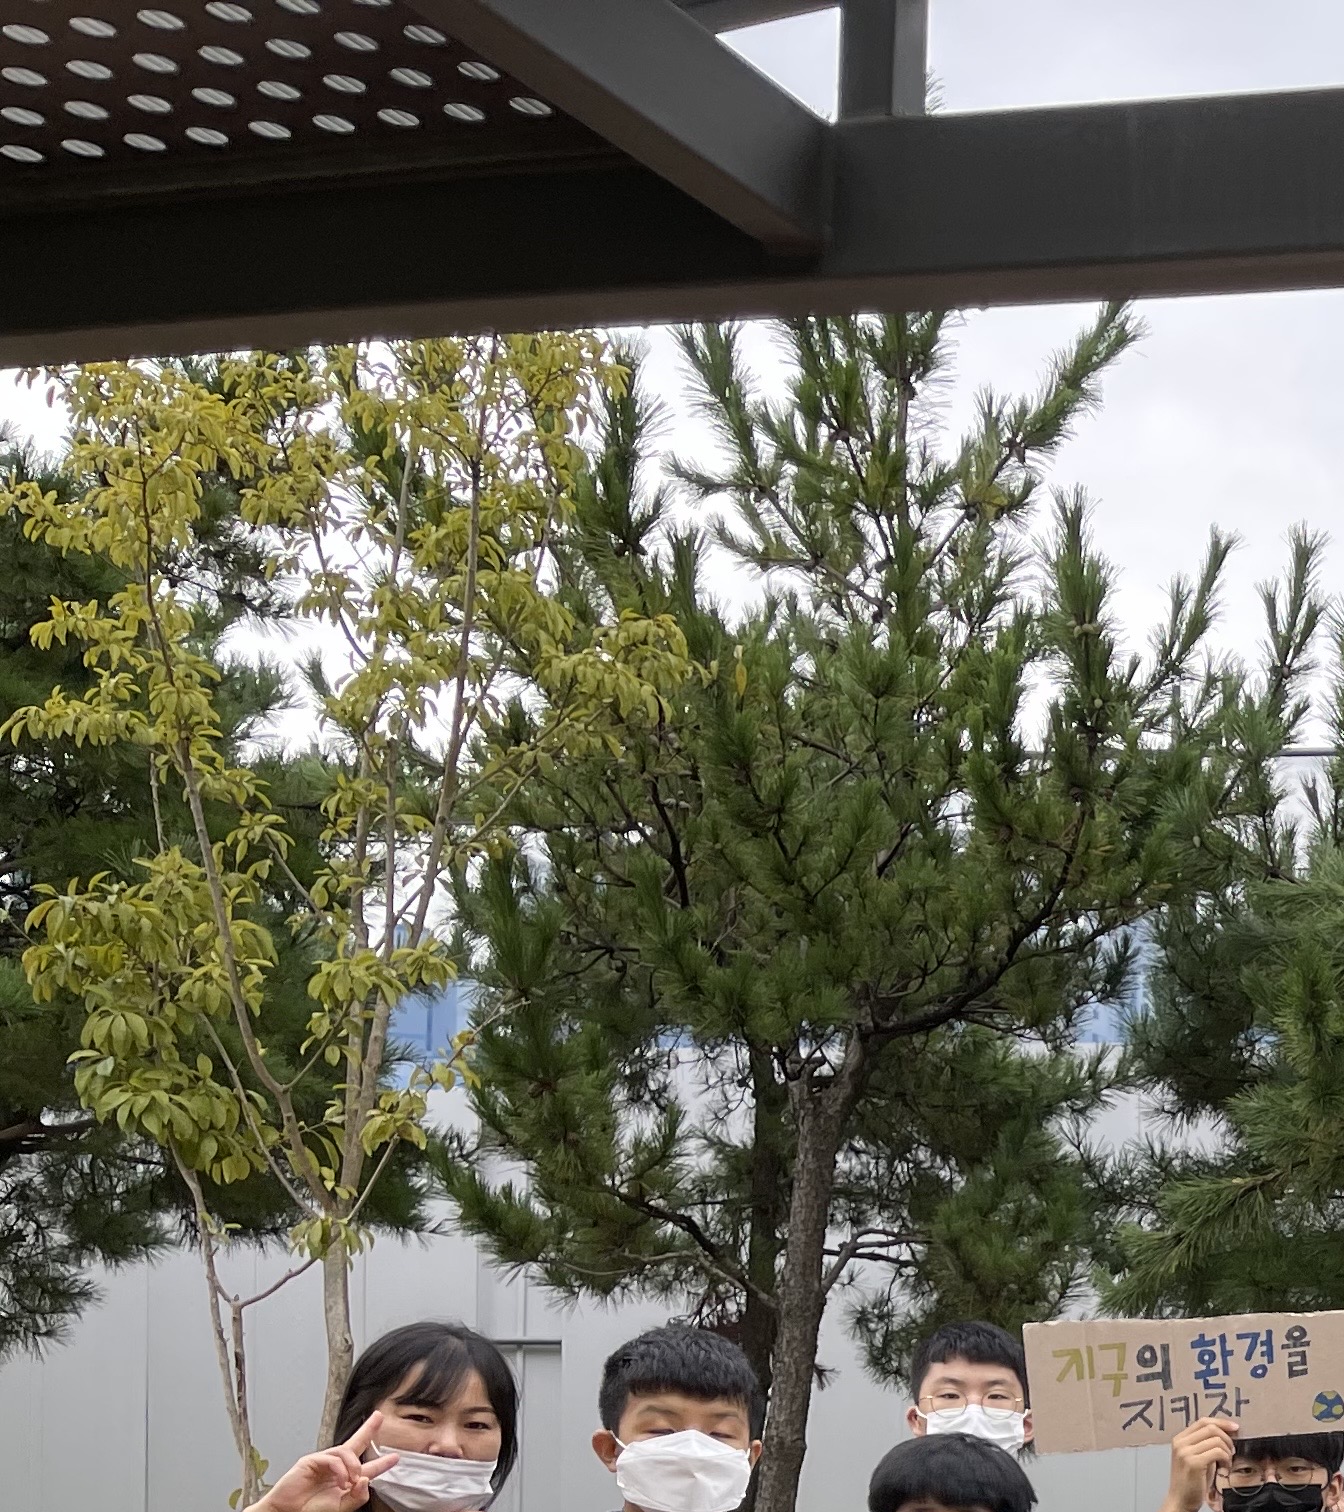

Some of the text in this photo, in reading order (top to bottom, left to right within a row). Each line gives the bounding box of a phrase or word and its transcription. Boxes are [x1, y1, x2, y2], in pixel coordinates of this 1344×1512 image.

[1052, 1325, 1312, 1397] 지구의 환경을
[1120, 1387, 1250, 1431] 지키자
